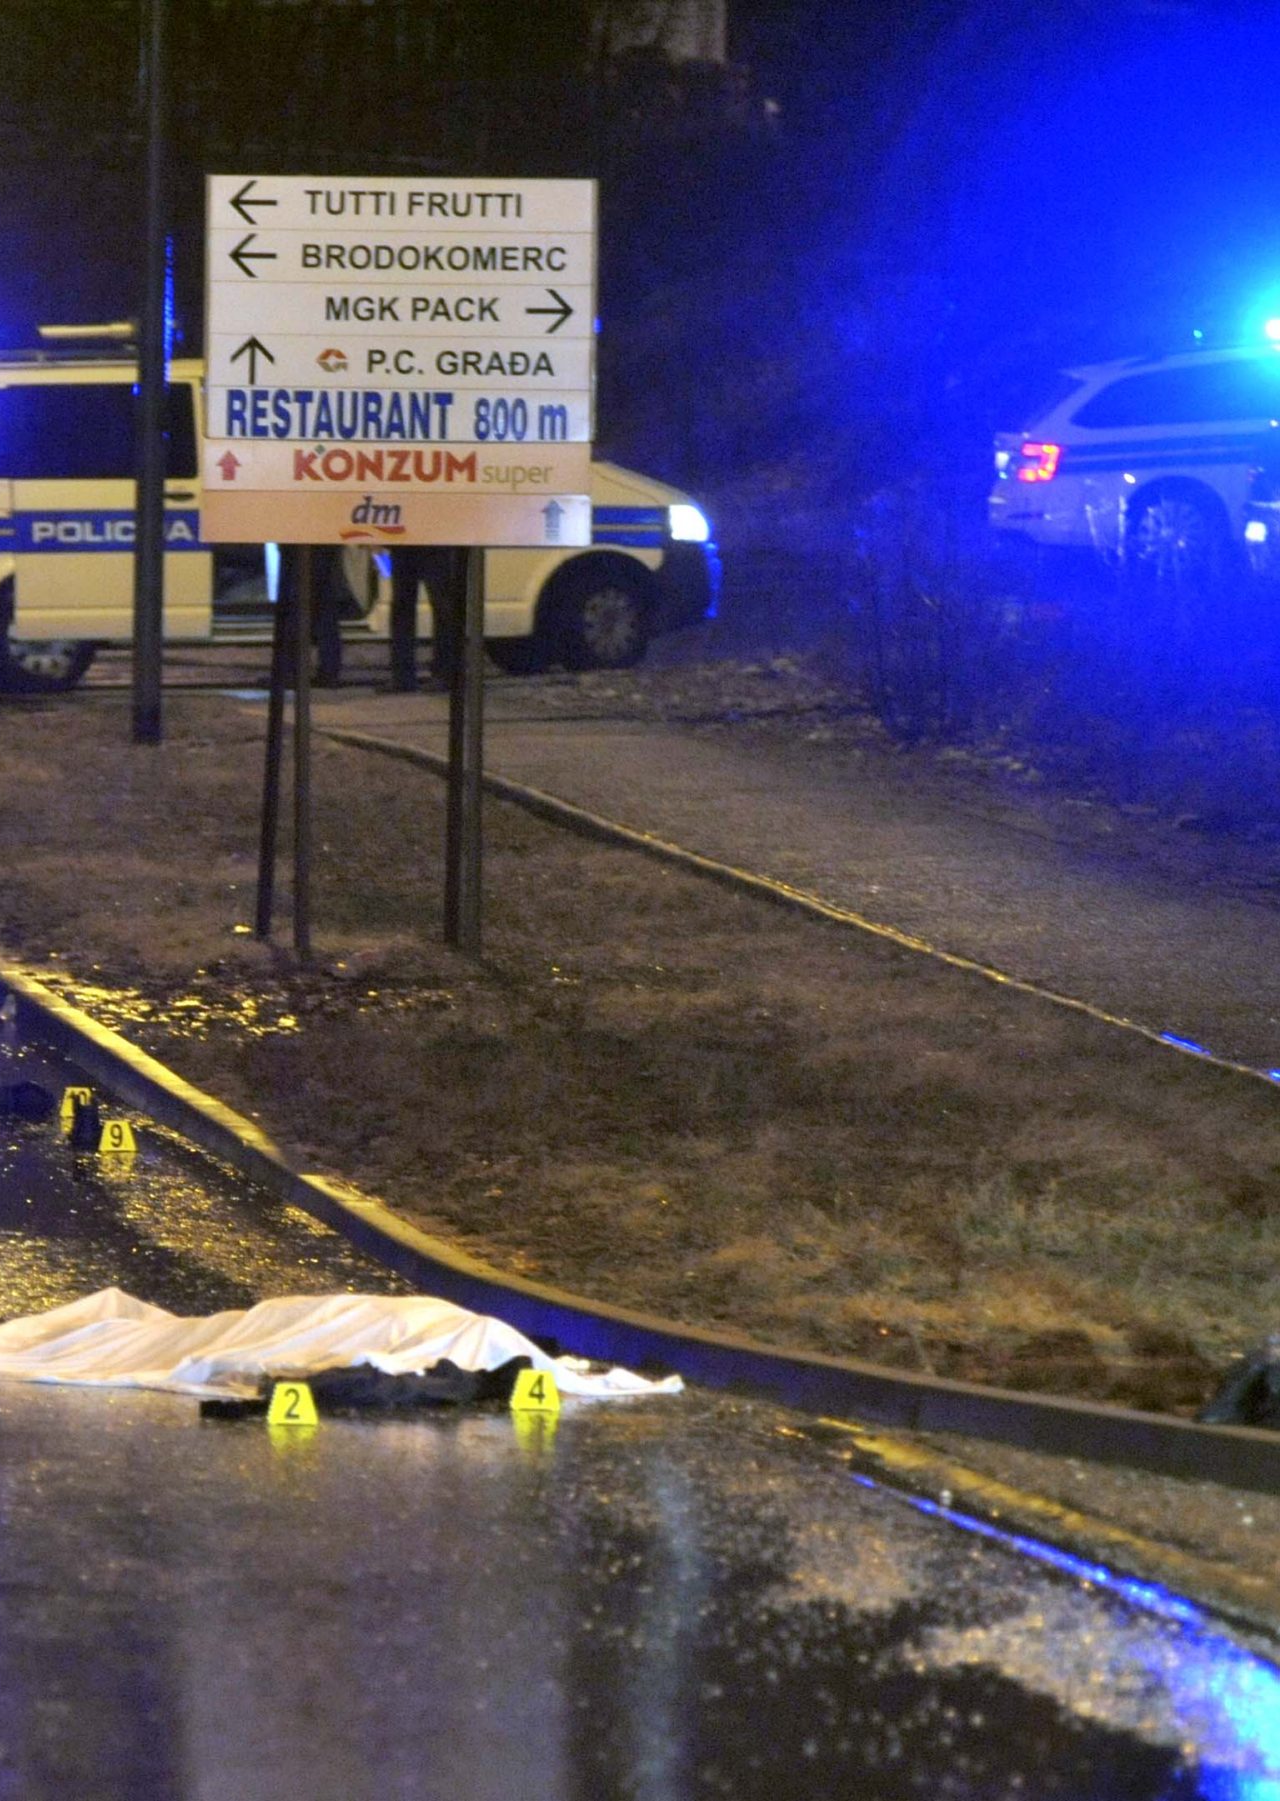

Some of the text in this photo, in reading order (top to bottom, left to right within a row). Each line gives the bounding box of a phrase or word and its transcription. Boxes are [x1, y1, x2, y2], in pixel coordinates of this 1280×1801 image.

[304, 189, 522, 218] TUTTI FRUTTI
[301, 244, 568, 272] BRODOKOMERC
[325, 296, 501, 322] MGK PACK
[366, 349, 555, 377] P.C. GRAĐA
[226, 388, 569, 442] RESTAURANT 800 m
[293, 447, 554, 490] KONZUM super
[350, 495, 402, 526] dm
[31, 520, 193, 543] POLICA
[110, 1123, 124, 1149] 9
[528, 1374, 546, 1404] 4
[284, 1388, 300, 1420] 2
